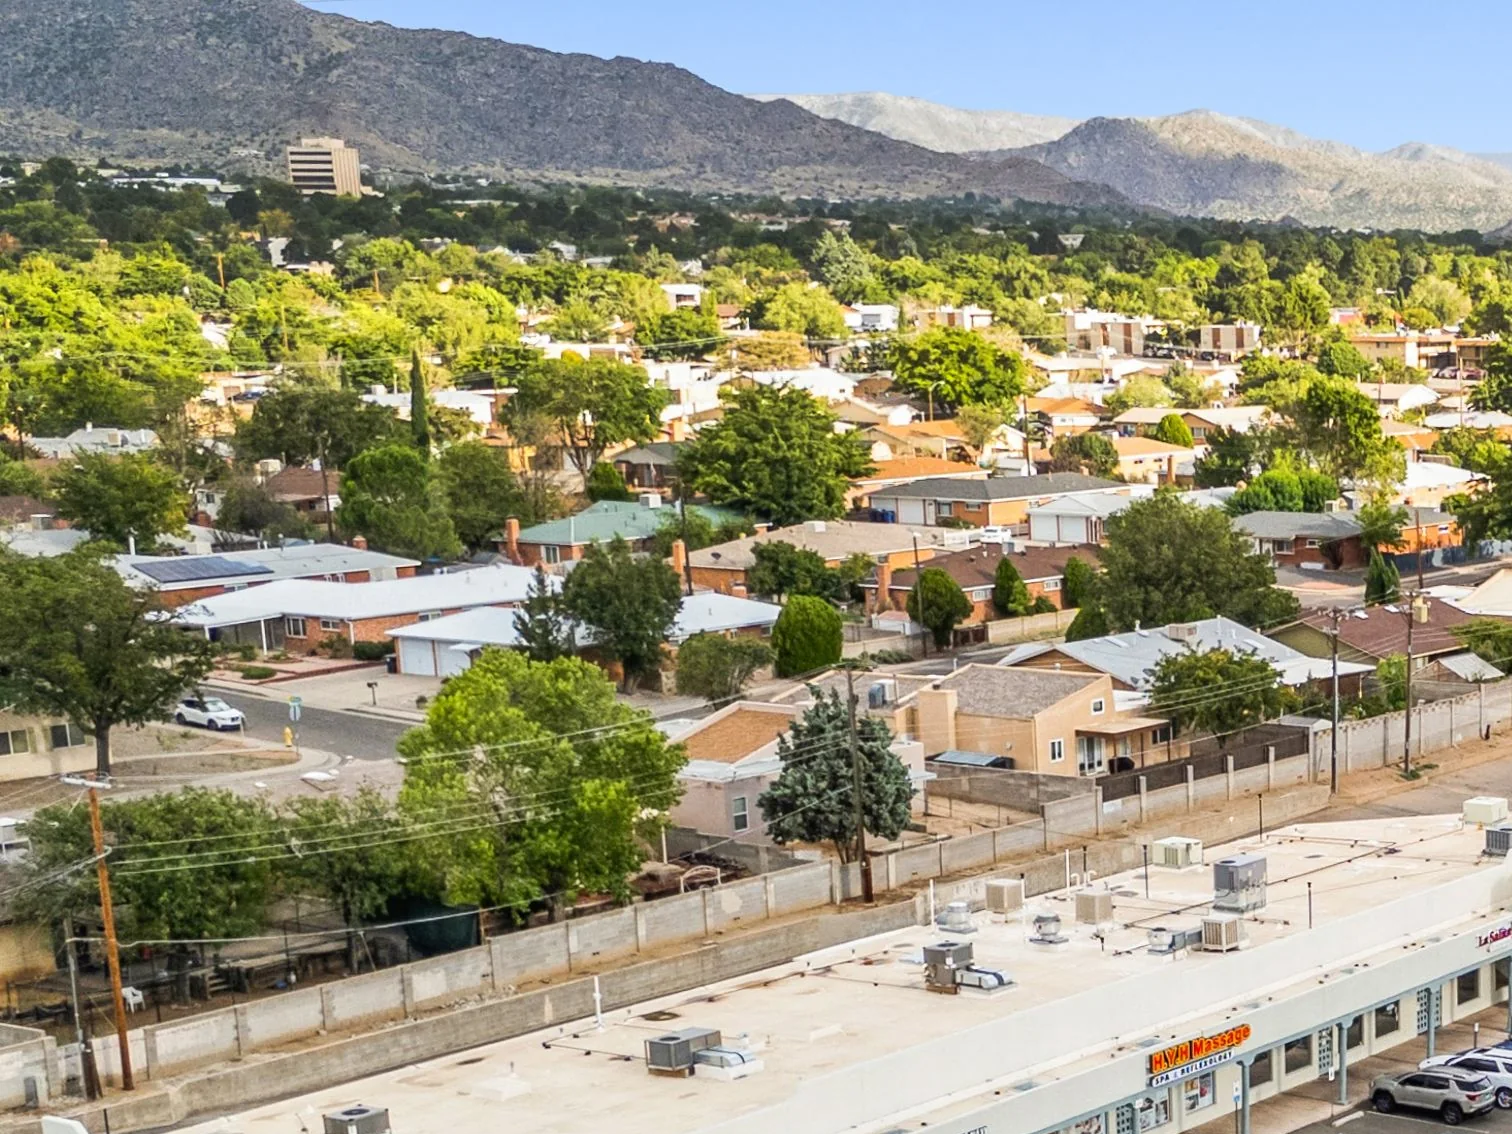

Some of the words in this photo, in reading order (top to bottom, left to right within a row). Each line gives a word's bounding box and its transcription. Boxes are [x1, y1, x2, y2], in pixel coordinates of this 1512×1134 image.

[1153, 1042, 1190, 1073] H.Y.H
[1192, 1024, 1251, 1057] Massage
[1155, 1074, 1170, 1085] SPA
[1180, 1050, 1232, 1076] REFLEXOLOGY
